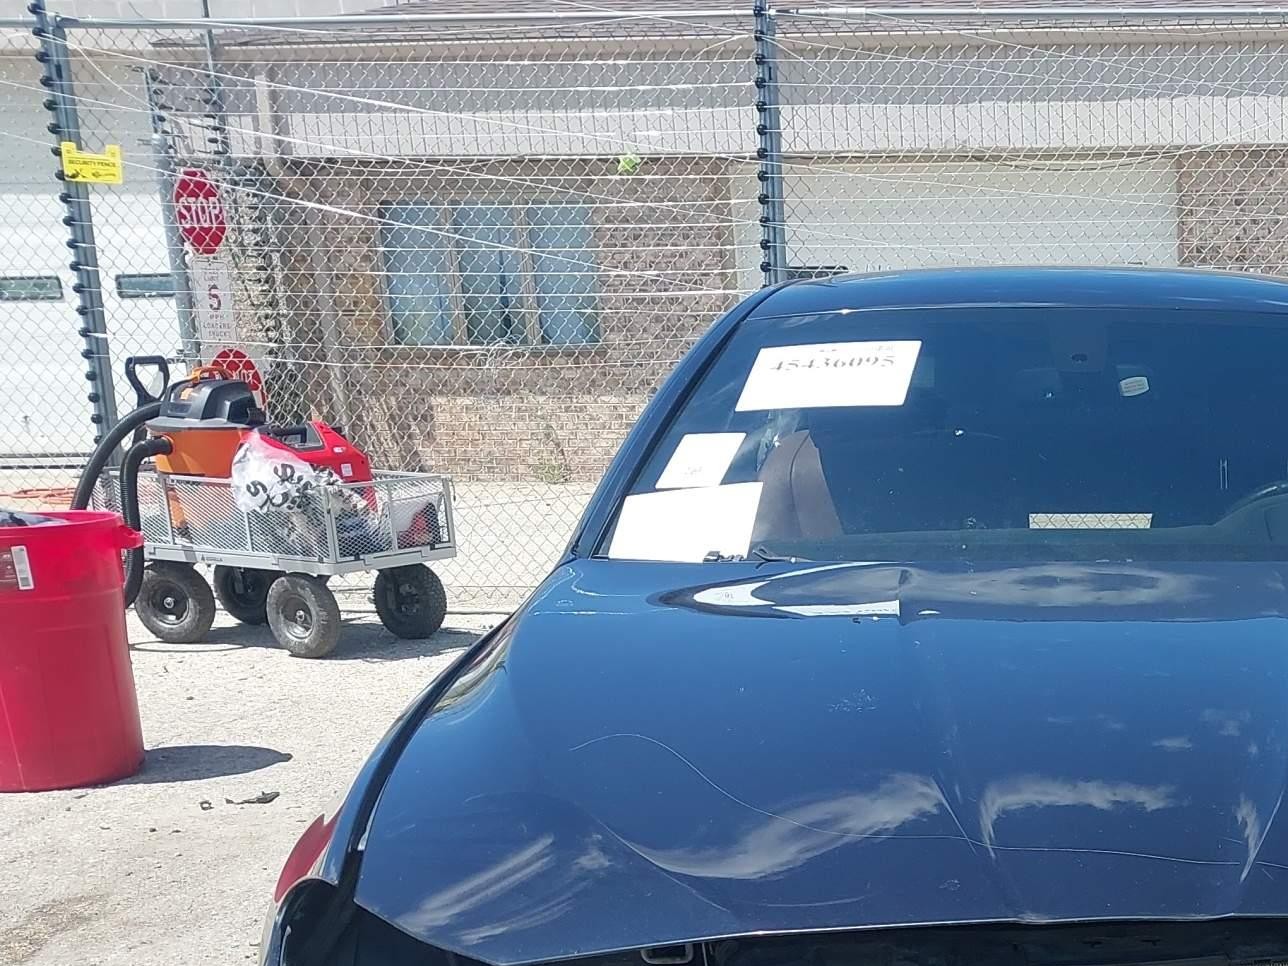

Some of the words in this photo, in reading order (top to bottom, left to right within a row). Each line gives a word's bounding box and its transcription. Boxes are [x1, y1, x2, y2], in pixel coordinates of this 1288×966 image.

[179, 196, 221, 228] STOP
[208, 283, 222, 313] 5
[769, 355, 896, 371] 45436095
